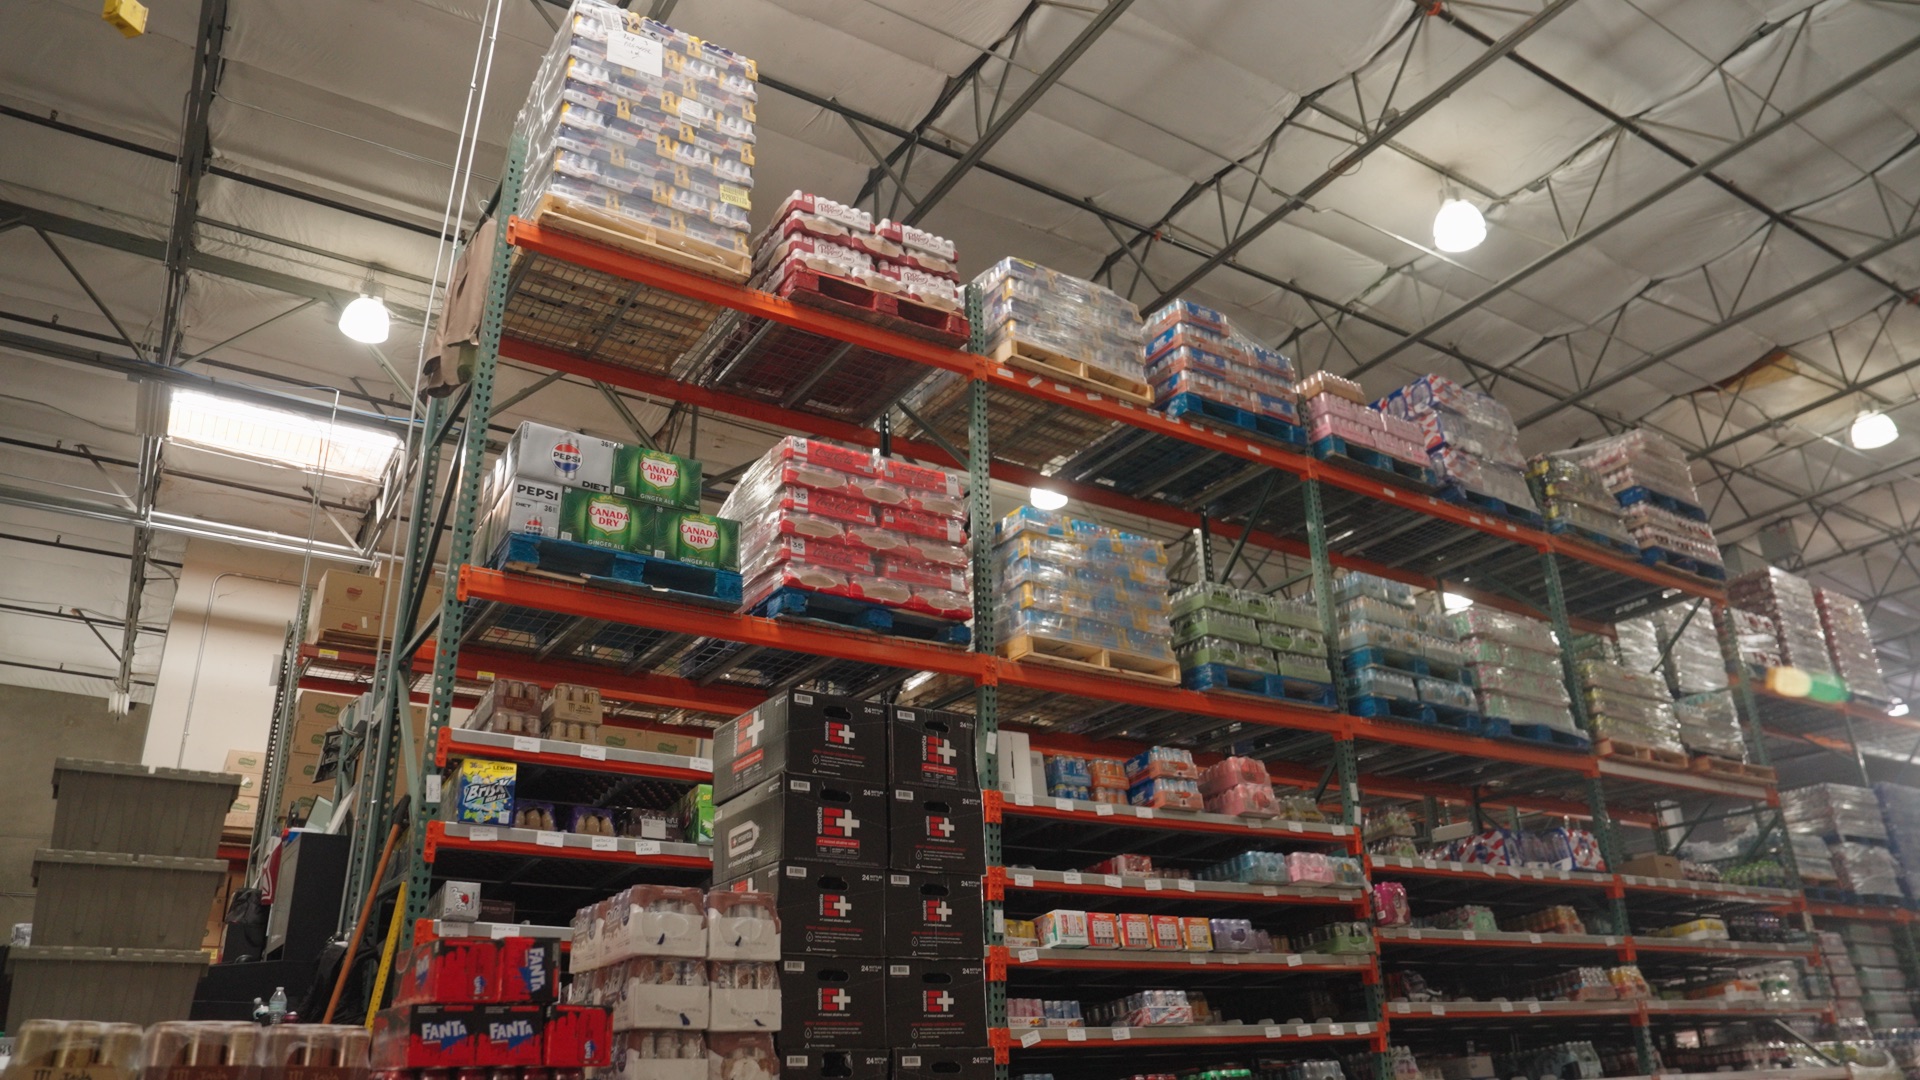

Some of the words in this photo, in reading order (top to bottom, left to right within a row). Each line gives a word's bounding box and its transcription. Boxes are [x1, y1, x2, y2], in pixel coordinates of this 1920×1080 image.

[553, 451, 581, 463] PEPSI
[793, 440, 806, 449] 35
[815, 448, 854, 465] Coca-Cola
[640, 461, 679, 478] CANADA
[650, 472, 669, 484] DRY
[582, 480, 609, 492] DIET
[516, 484, 559, 501] PEPSI
[795, 492, 807, 501] 35
[640, 493, 663, 503] GINGER
[663, 497, 675, 506] ALE
[544, 505, 552, 513] 36
[588, 505, 630, 523] CANADA
[598, 517, 620, 528] DRY
[525, 525, 543, 533] PEPSI
[680, 523, 719, 540] CANADA
[588, 539, 612, 549] GINGER
[613, 543, 624, 551] ALE
[689, 534, 710, 545] DRY
[792, 541, 804, 550] 35
[680, 556, 703, 566] GINGER
[704, 560, 715, 568] ALE
[528, 947, 545, 992] FANTA
[421, 1020, 467, 1040] FANTA
[489, 1020, 534, 1039] FANTA
